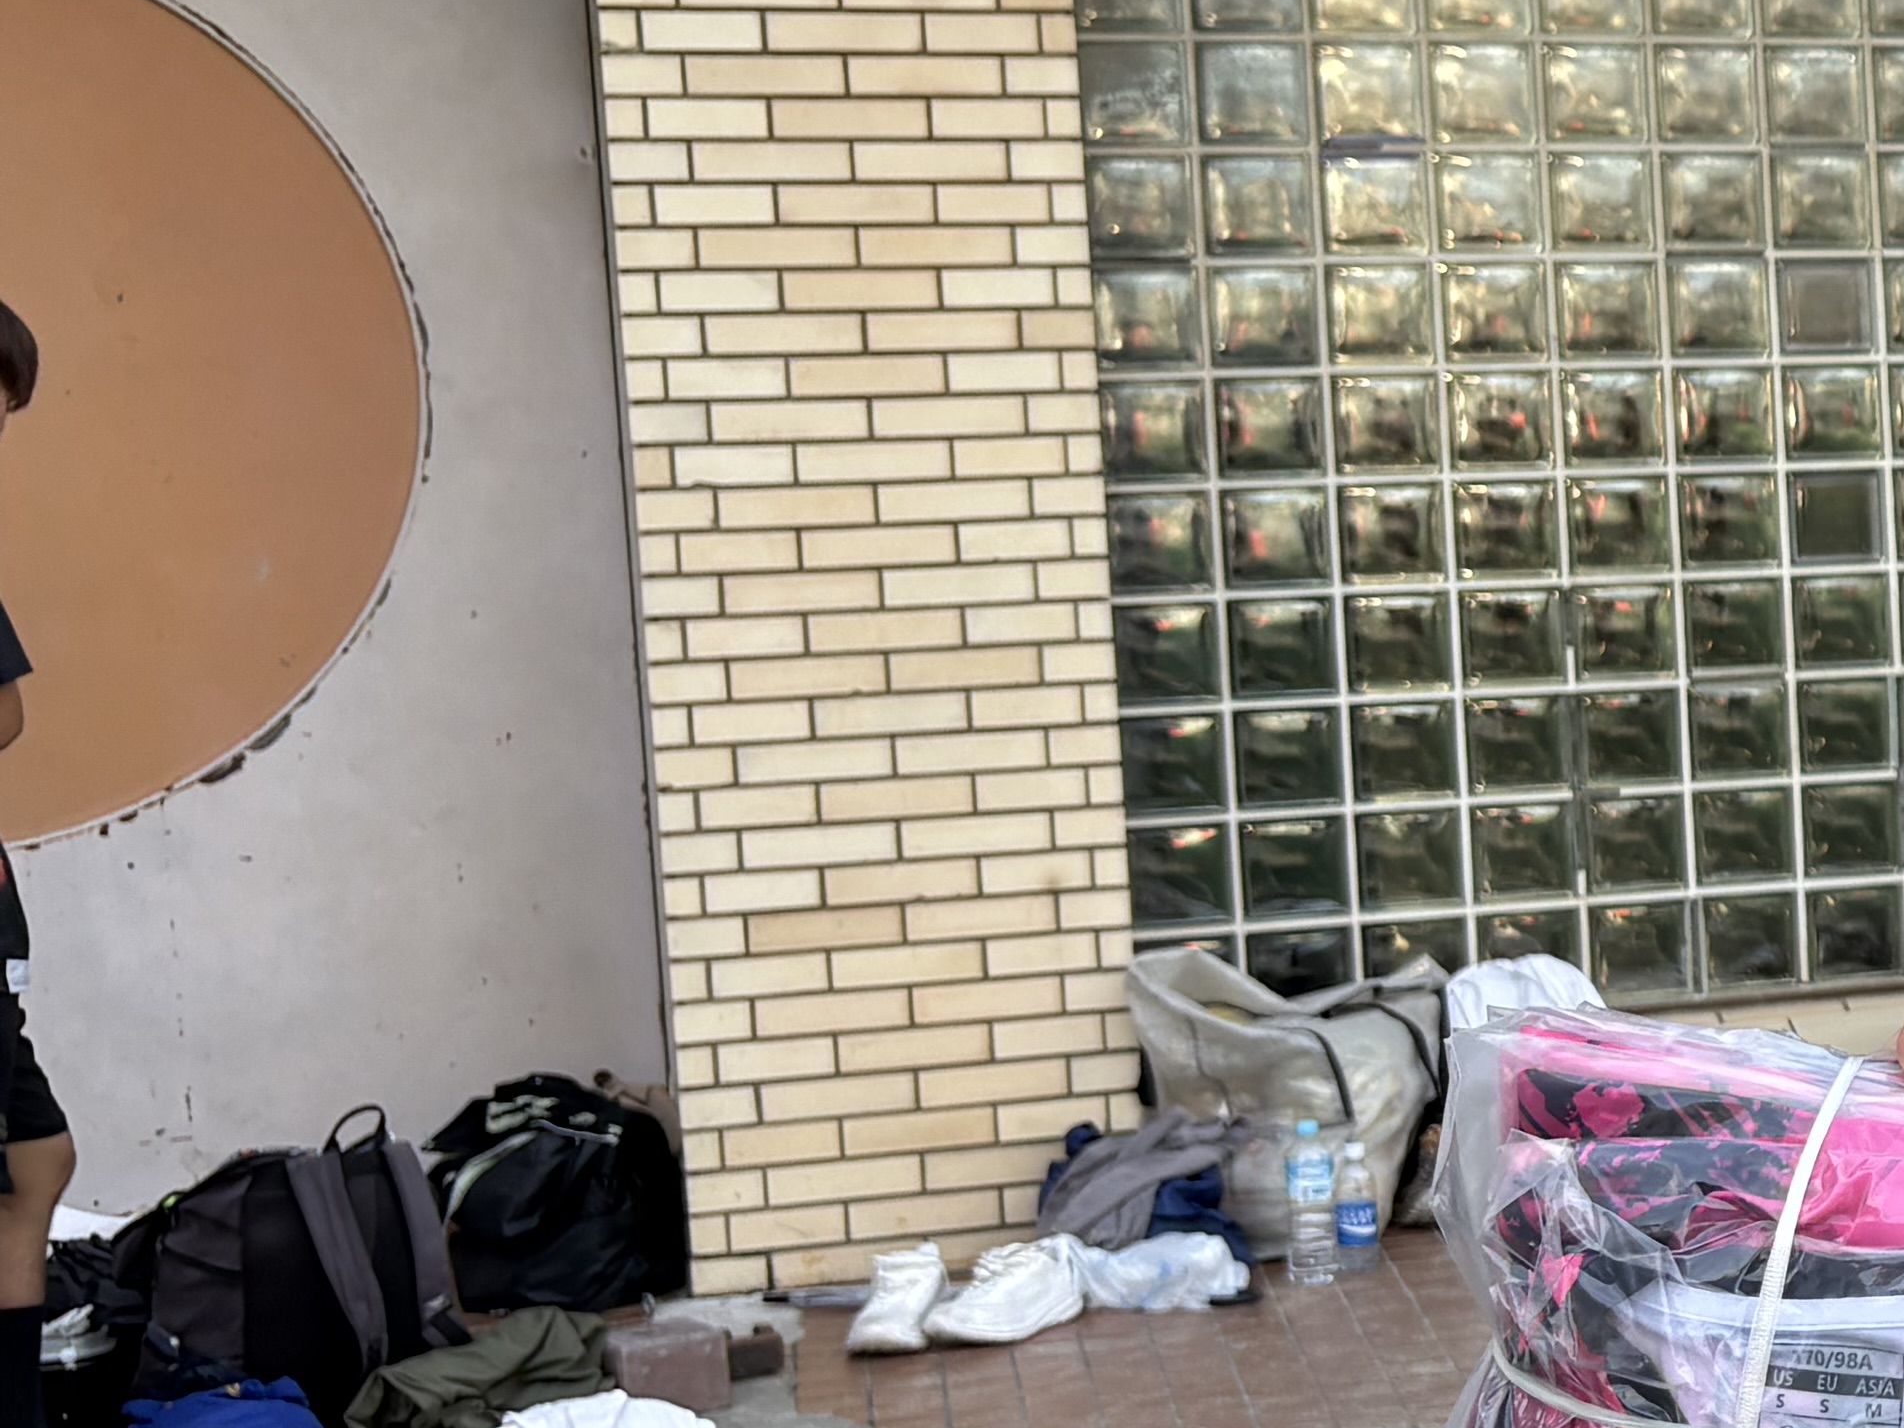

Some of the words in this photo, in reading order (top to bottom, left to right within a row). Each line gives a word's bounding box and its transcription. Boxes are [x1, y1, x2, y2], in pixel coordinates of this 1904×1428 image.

[1772, 1368, 1794, 1387] US
[1816, 1374, 1839, 1391] EU
[1855, 1377, 1895, 1396] ASIA
[1775, 1393, 1785, 1409] S
[1819, 1399, 1830, 1414] S
[1865, 1402, 1883, 1419] M
